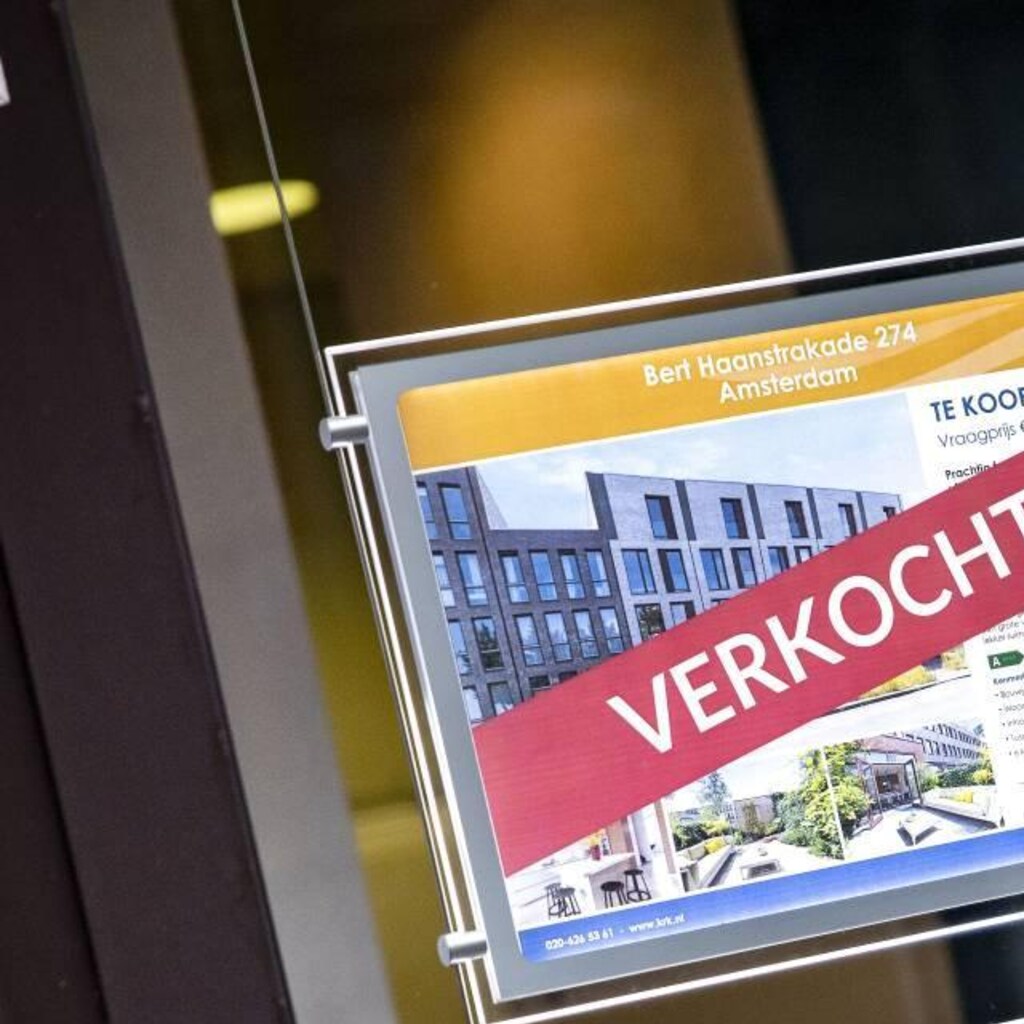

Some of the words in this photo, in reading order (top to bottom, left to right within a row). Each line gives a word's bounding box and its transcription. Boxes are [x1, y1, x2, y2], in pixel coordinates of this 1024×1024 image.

[642, 361, 692, 387] Bert
[697, 332, 869, 378] Haanstrakade
[874, 321, 918, 349] 274
[719, 364, 858, 404] Amsterdam
[930, 400, 956, 422] TE
[937, 422, 1016, 448] Vraagprijs
[992, 656, 1001, 667] A
[545, 933, 586, 950] 020-626
[587, 930, 600, 942] 53
[602, 928, 614, 939] 61
[628, 913, 685, 933] www.krk.nl
